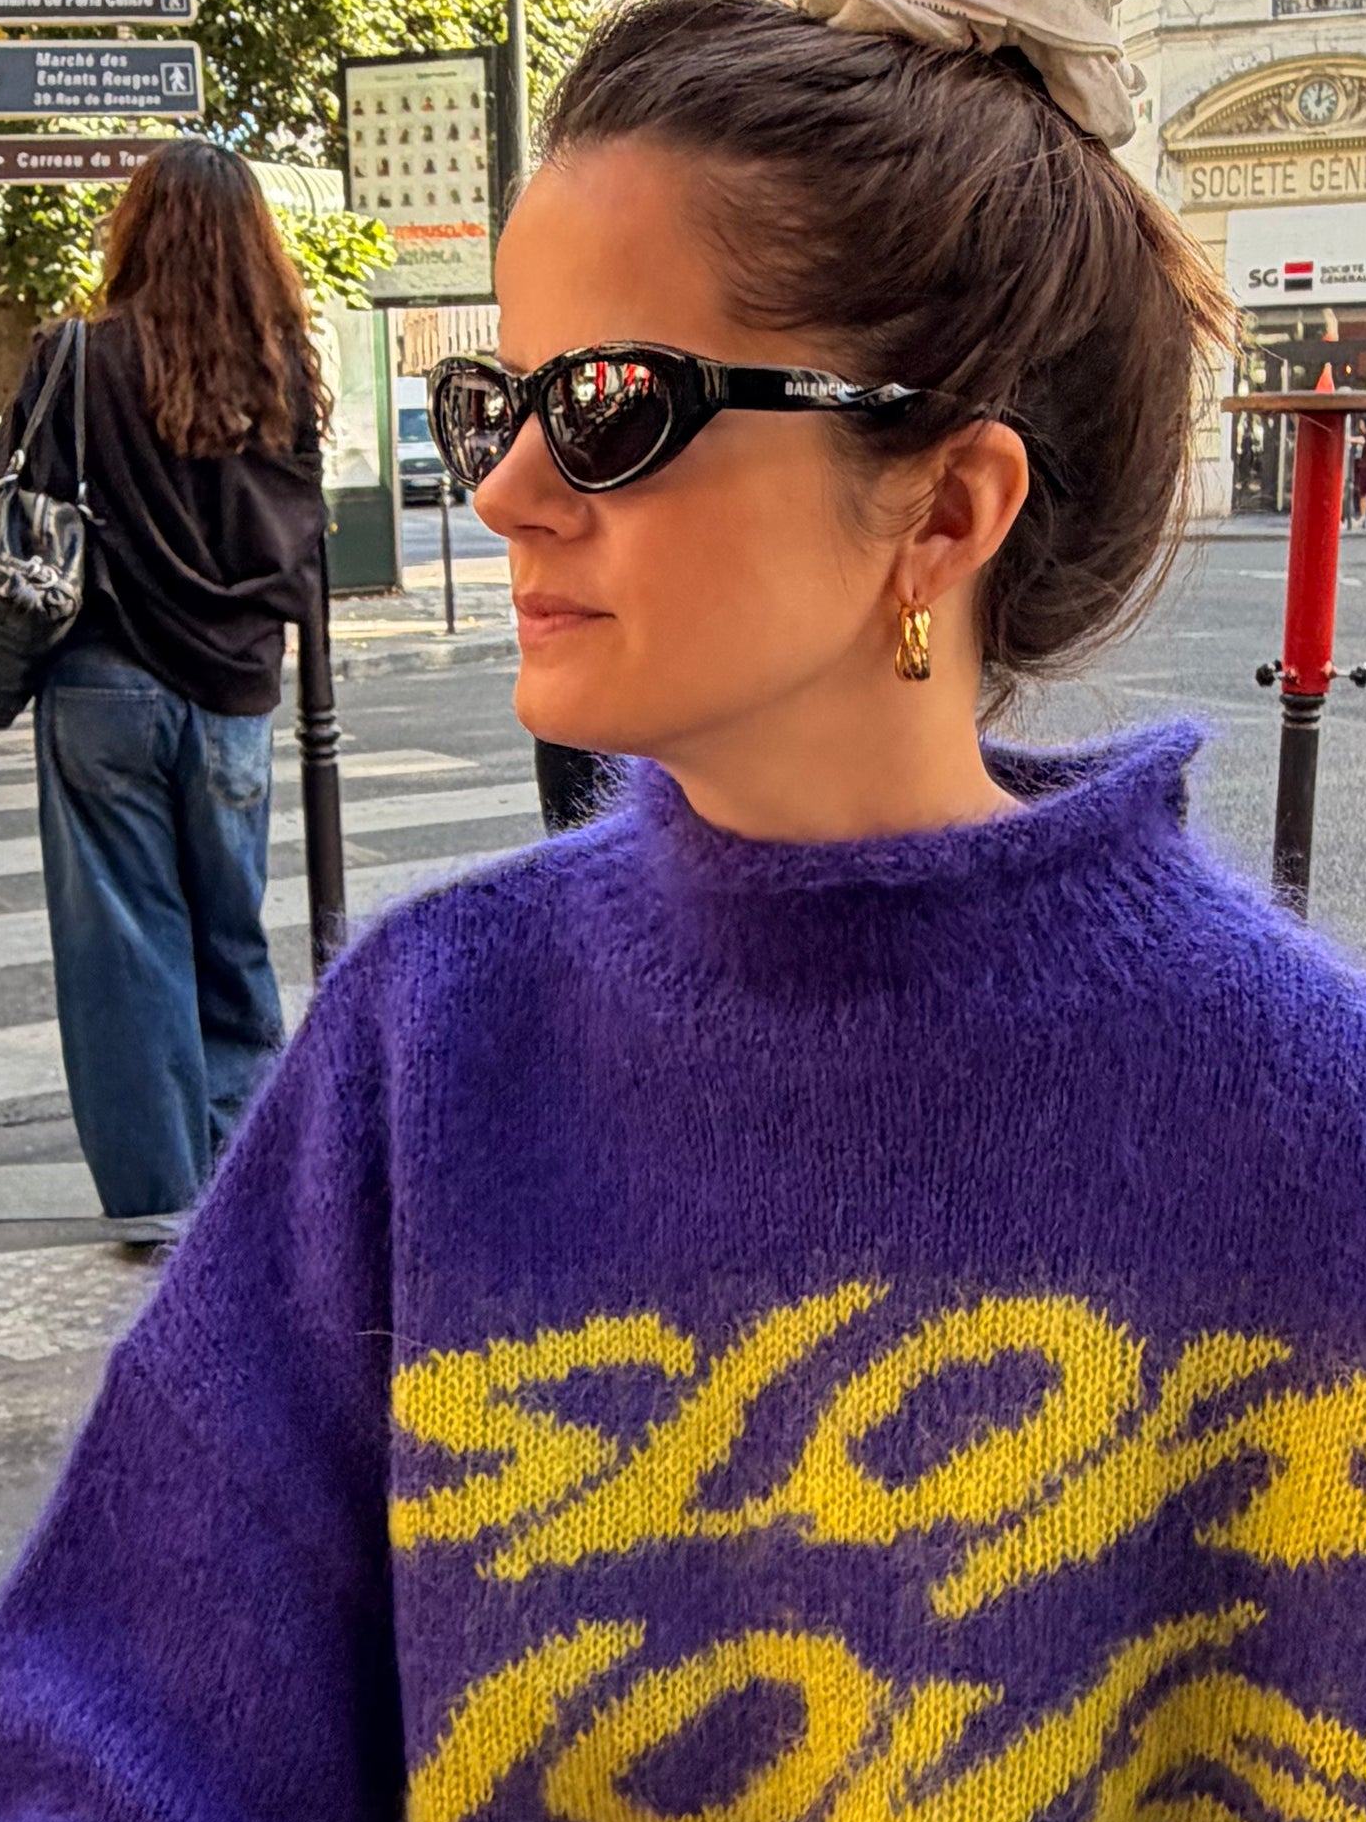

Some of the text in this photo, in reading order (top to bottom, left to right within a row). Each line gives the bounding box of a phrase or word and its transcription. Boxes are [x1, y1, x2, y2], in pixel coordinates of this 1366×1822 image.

[36, 52, 128, 67] Marché des
[37, 70, 160, 90] Enfants Rouges
[84, 92, 100, 106] de
[104, 92, 161, 108] Bretagne
[16, 151, 149, 168] Carreau du Tem
[1190, 156, 1298, 199] SOCIÉTÉ
[1248, 268, 1279, 289] SG
